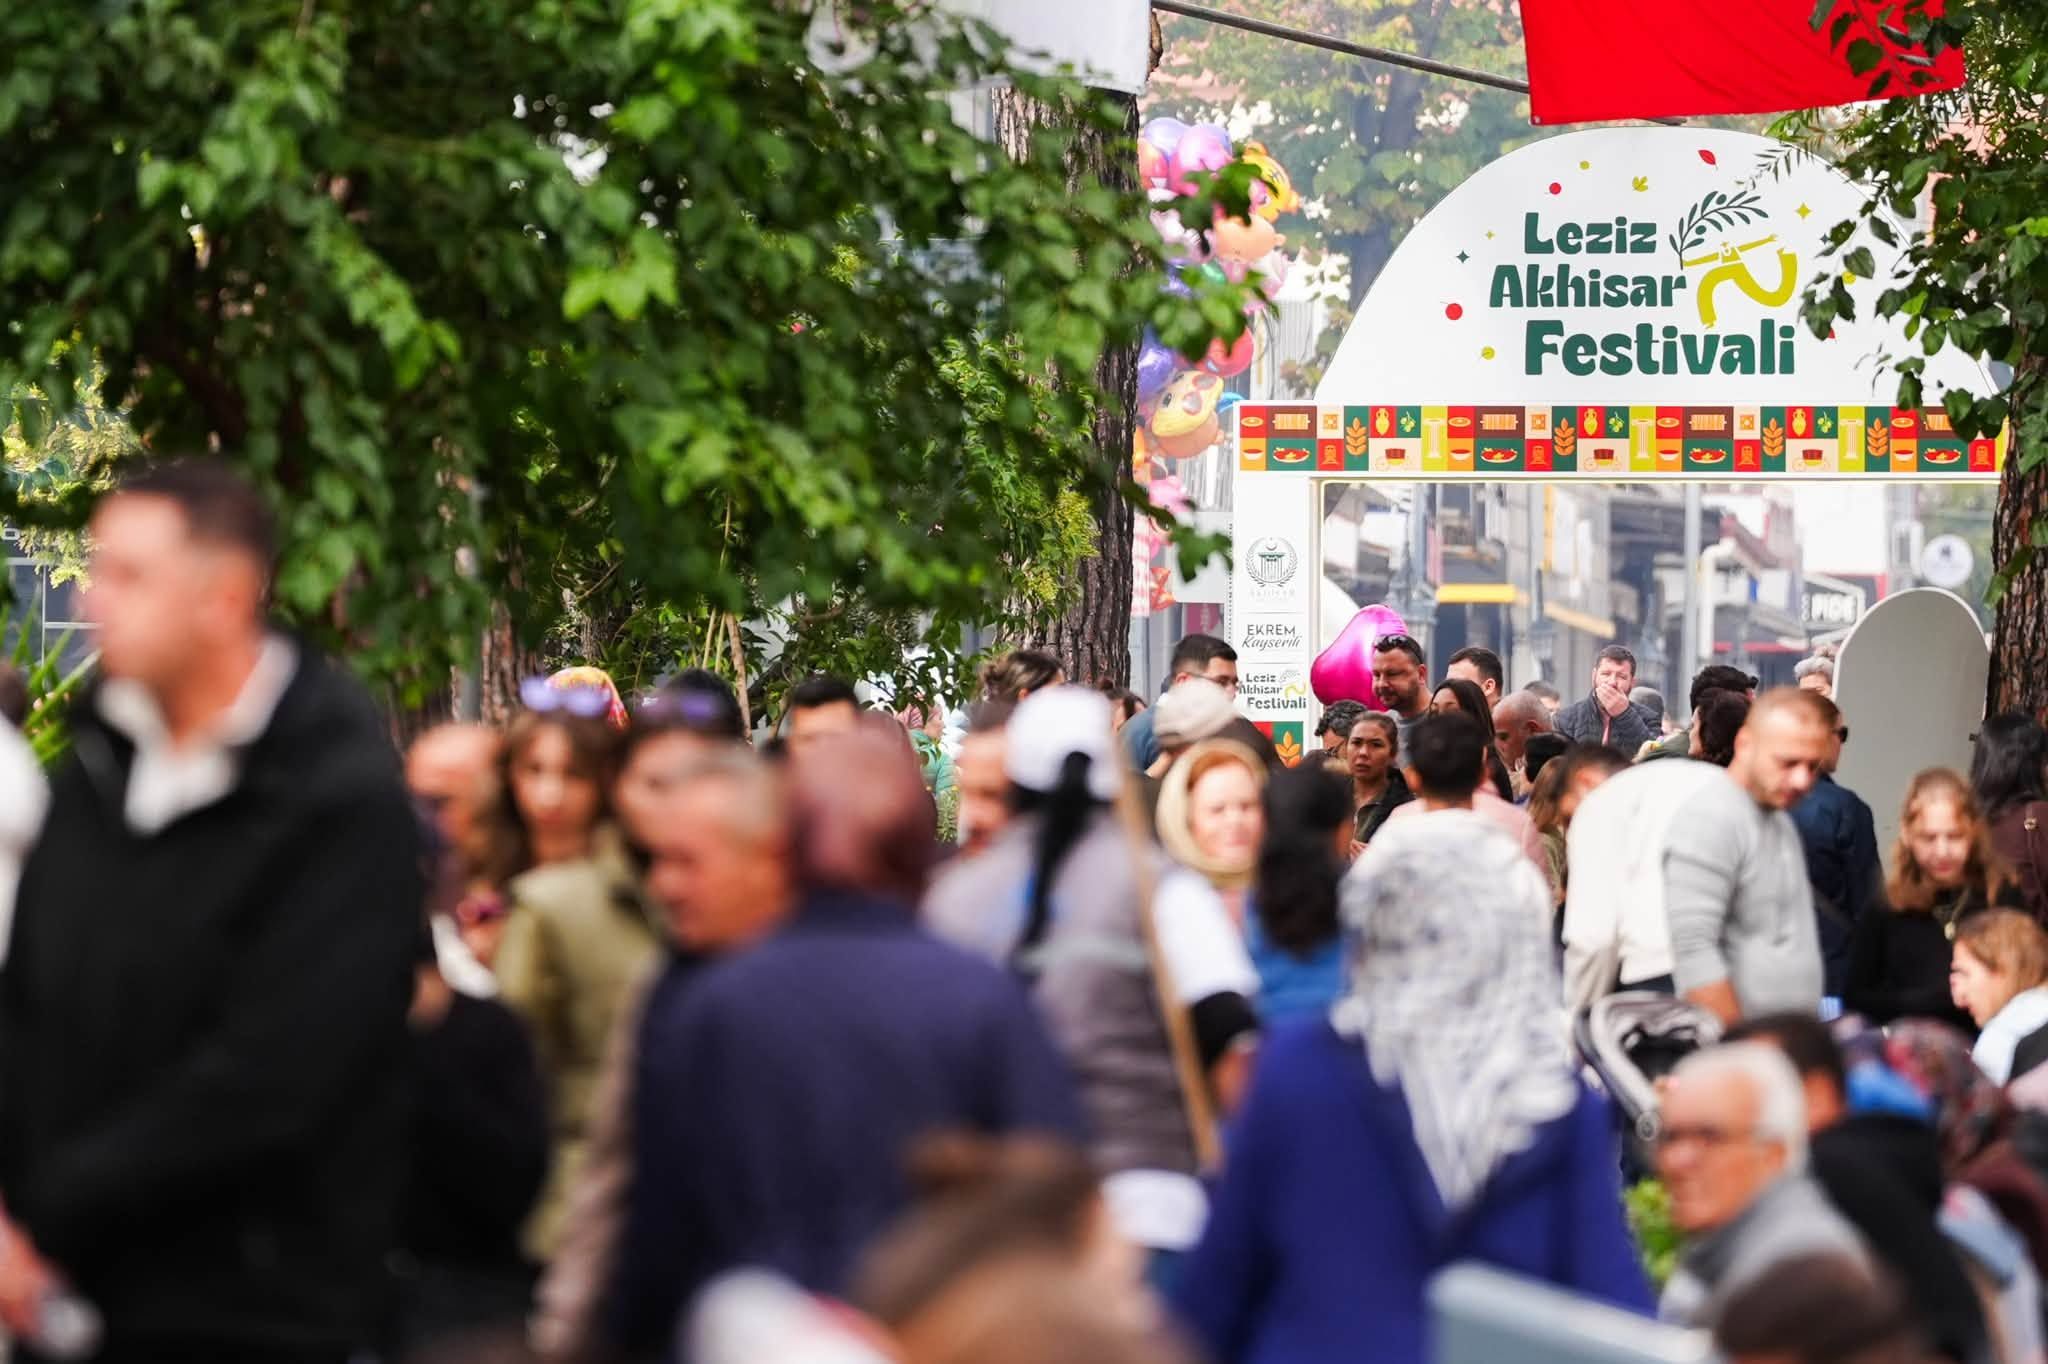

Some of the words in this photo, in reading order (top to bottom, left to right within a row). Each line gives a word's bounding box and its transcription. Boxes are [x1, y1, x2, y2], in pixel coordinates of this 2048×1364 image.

[1524, 213, 1657, 254] Leziz
[1489, 264, 1687, 308] Akhisar
[1525, 318, 1795, 376] Festivali
[1247, 624, 1295, 635] EKREM
[1242, 635, 1302, 651] Kayserili
[1245, 673, 1276, 683] Leziz
[1246, 696, 1307, 710] Festivali
